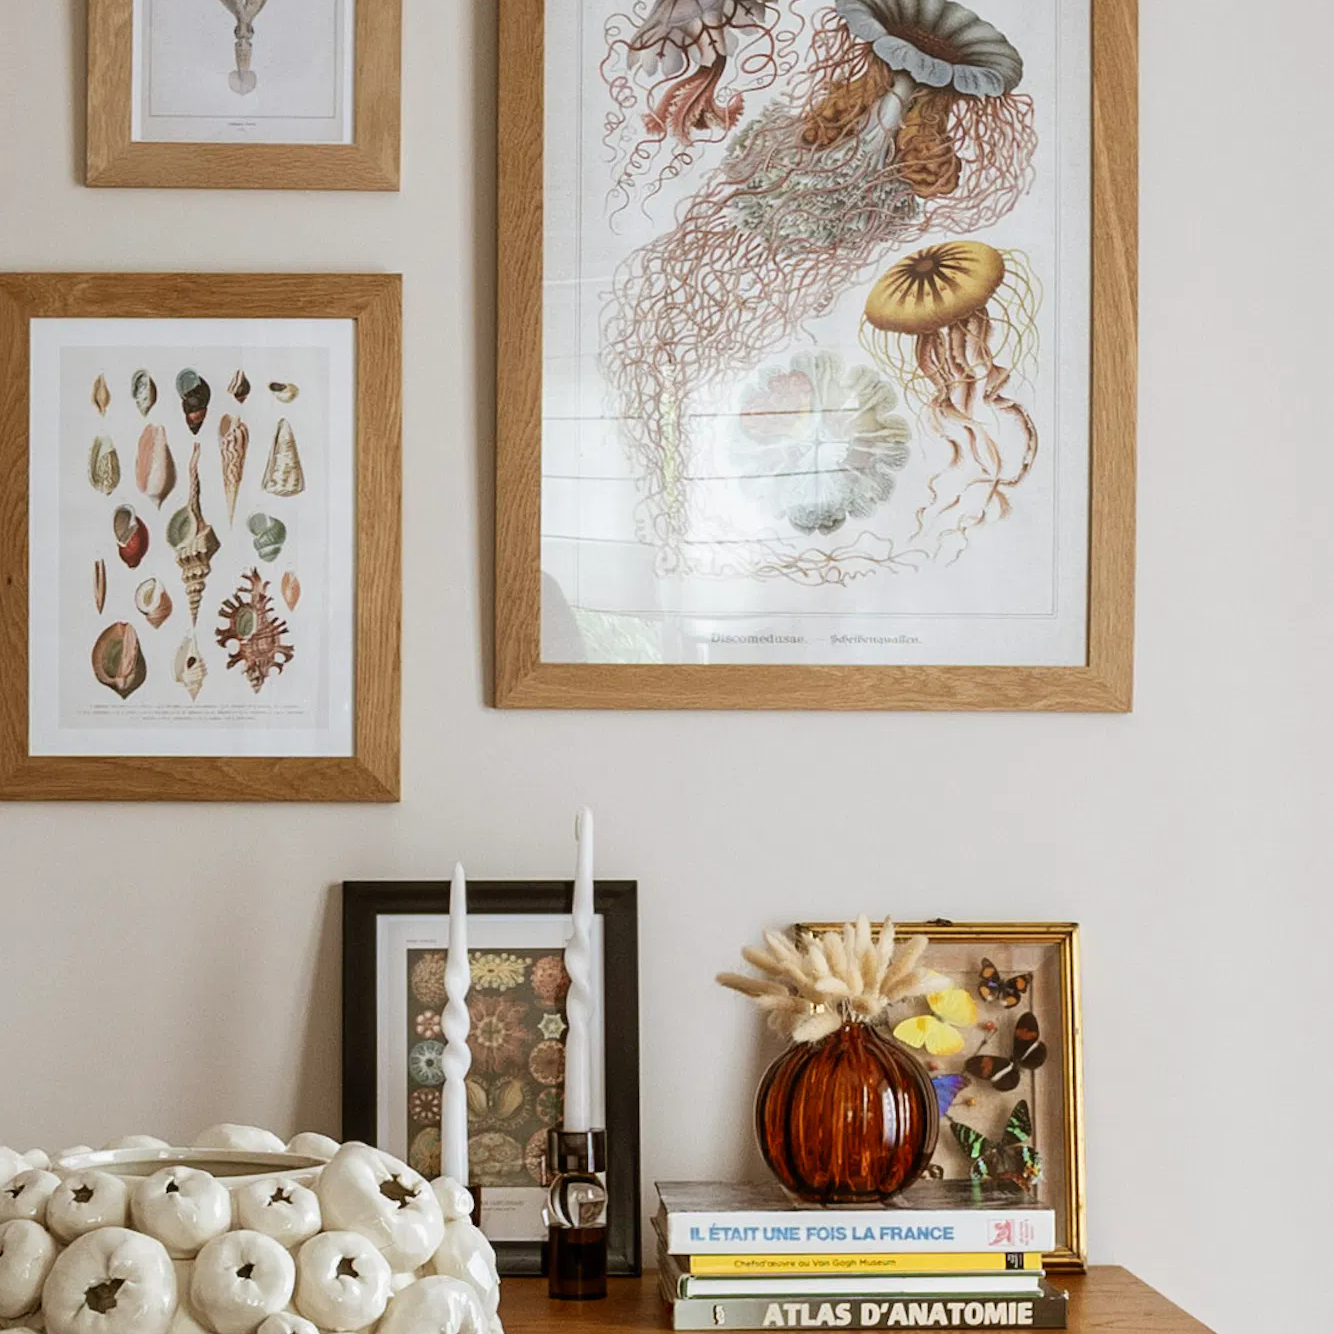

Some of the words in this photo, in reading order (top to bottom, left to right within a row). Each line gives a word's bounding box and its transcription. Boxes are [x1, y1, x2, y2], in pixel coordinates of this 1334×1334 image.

[690, 1226, 705, 1241] IL
[708, 1223, 760, 1241] ÉTAIT
[763, 1226, 801, 1241] UNE
[806, 1226, 847, 1241] FOIS
[851, 1226, 876, 1241] LA
[879, 1226, 955, 1241] FRANCE
[812, 1259, 830, 1267] Van
[832, 1259, 858, 1268] Gogh
[859, 1259, 897, 1267] Museum
[762, 1302, 852, 1327] ATLAS
[860, 1301, 1034, 1326] D'ANATOMIE
